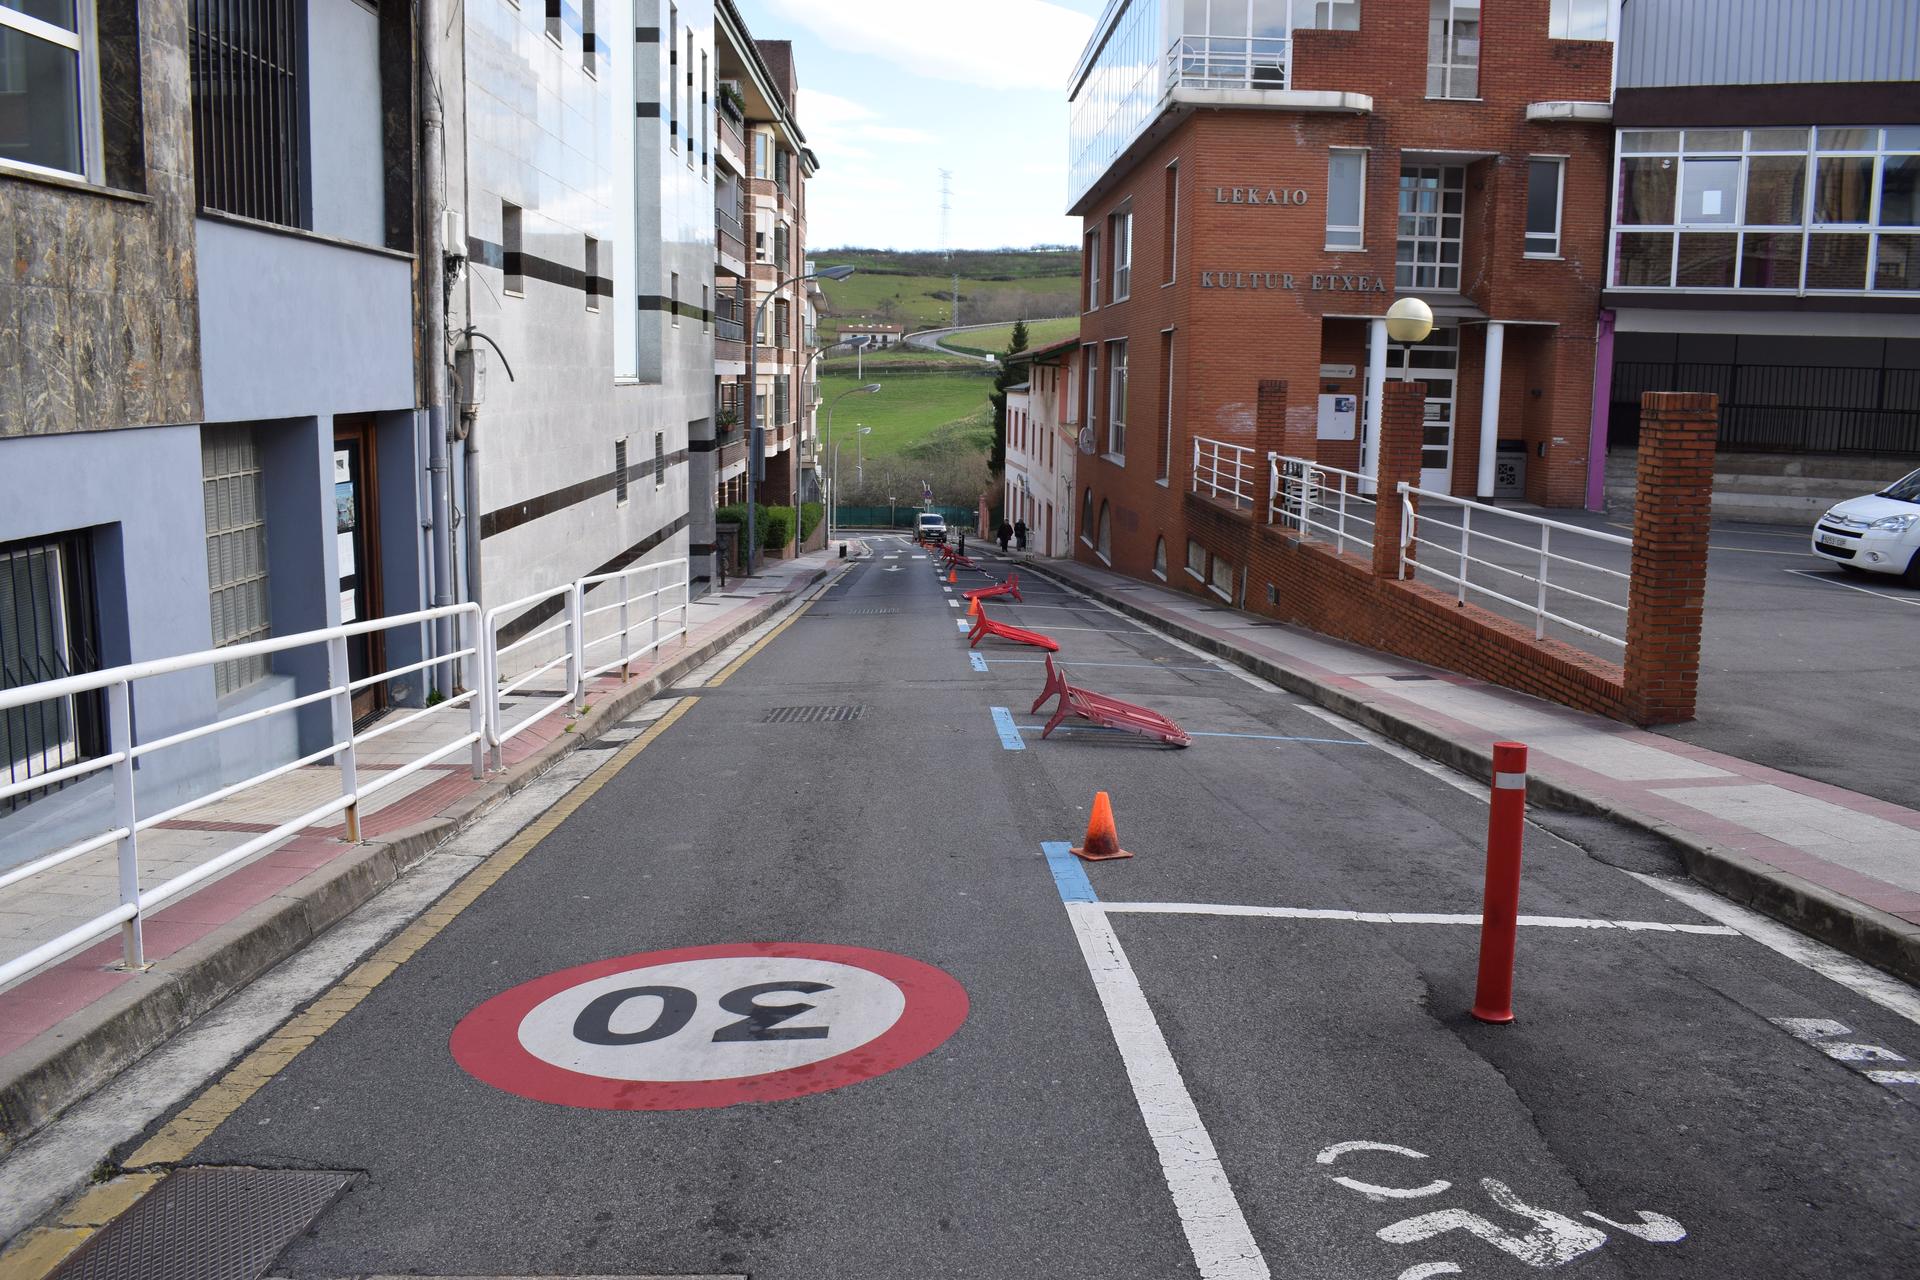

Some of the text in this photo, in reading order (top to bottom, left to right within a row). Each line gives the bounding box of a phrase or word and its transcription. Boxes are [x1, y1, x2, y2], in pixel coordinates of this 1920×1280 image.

[1215, 187, 1308, 205] LEKAIO
[1201, 272, 1386, 292] KULTUR ETXEA
[573, 980, 836, 1046] 30
